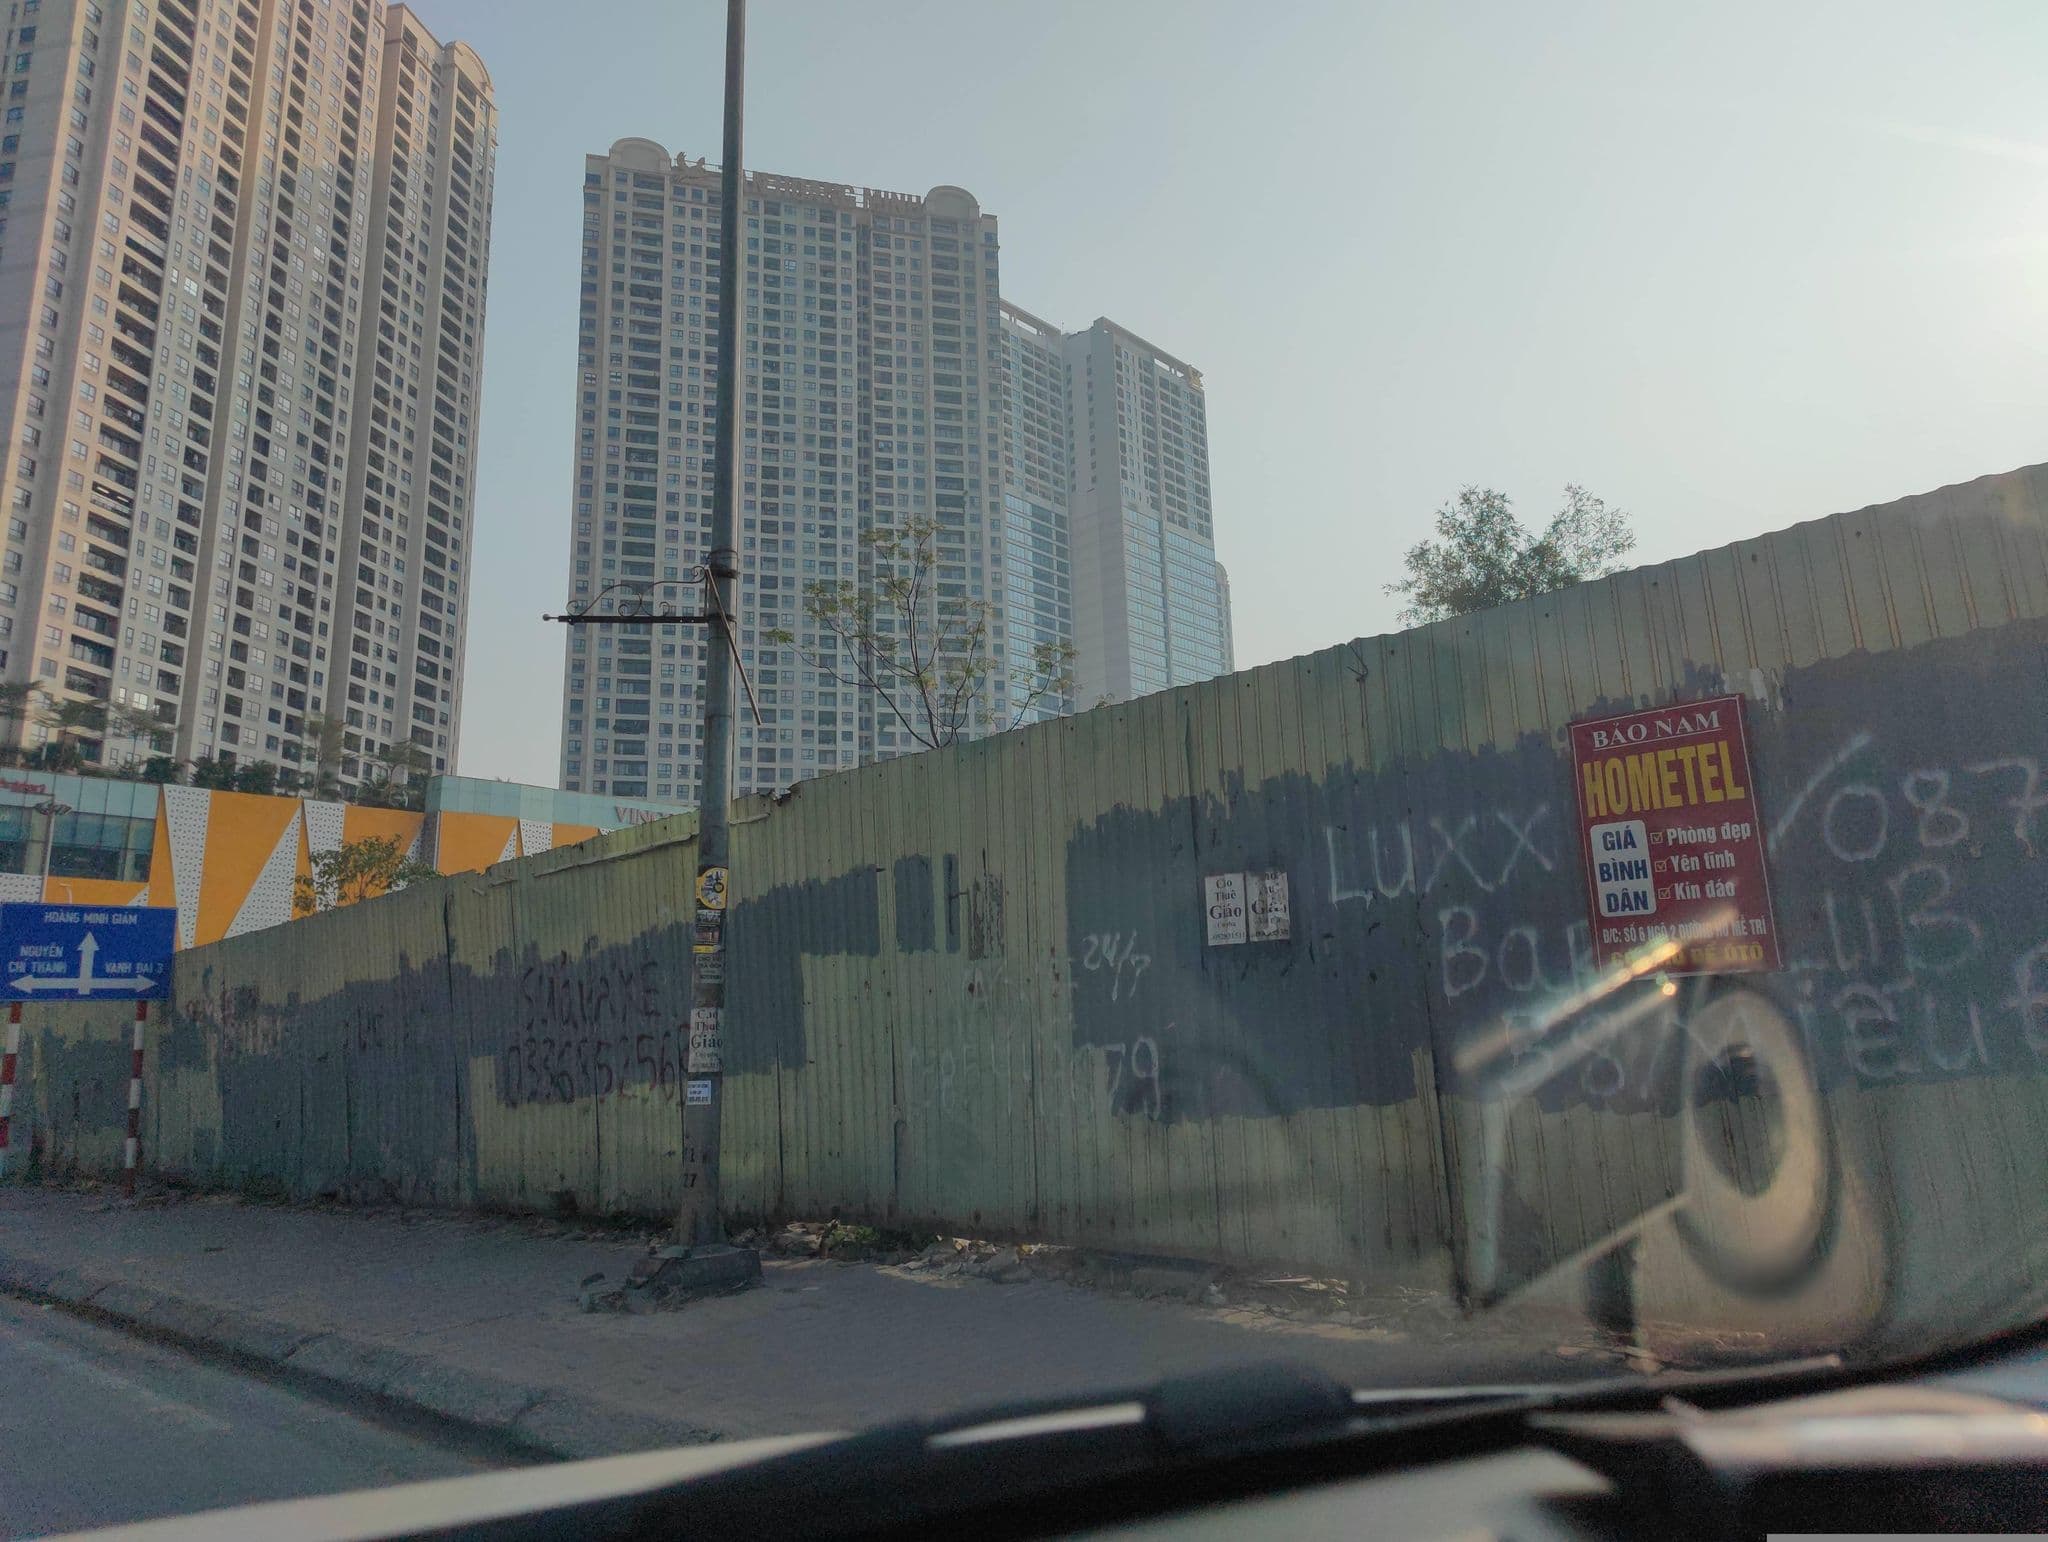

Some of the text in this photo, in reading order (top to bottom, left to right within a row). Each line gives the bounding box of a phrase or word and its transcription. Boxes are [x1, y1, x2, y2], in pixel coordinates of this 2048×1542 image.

[1656, 711, 1721, 738] NAM
[1583, 740, 1746, 818] HOMETEL
[1602, 825, 1637, 851] GIÁ
[1667, 822, 1752, 847] Phòng đẹp
[1599, 858, 1649, 883] BÌNH
[1670, 850, 1736, 873] Yên tĩnh
[1605, 888, 1649, 913] DÂN
[1674, 879, 1737, 901] Kín đáo
